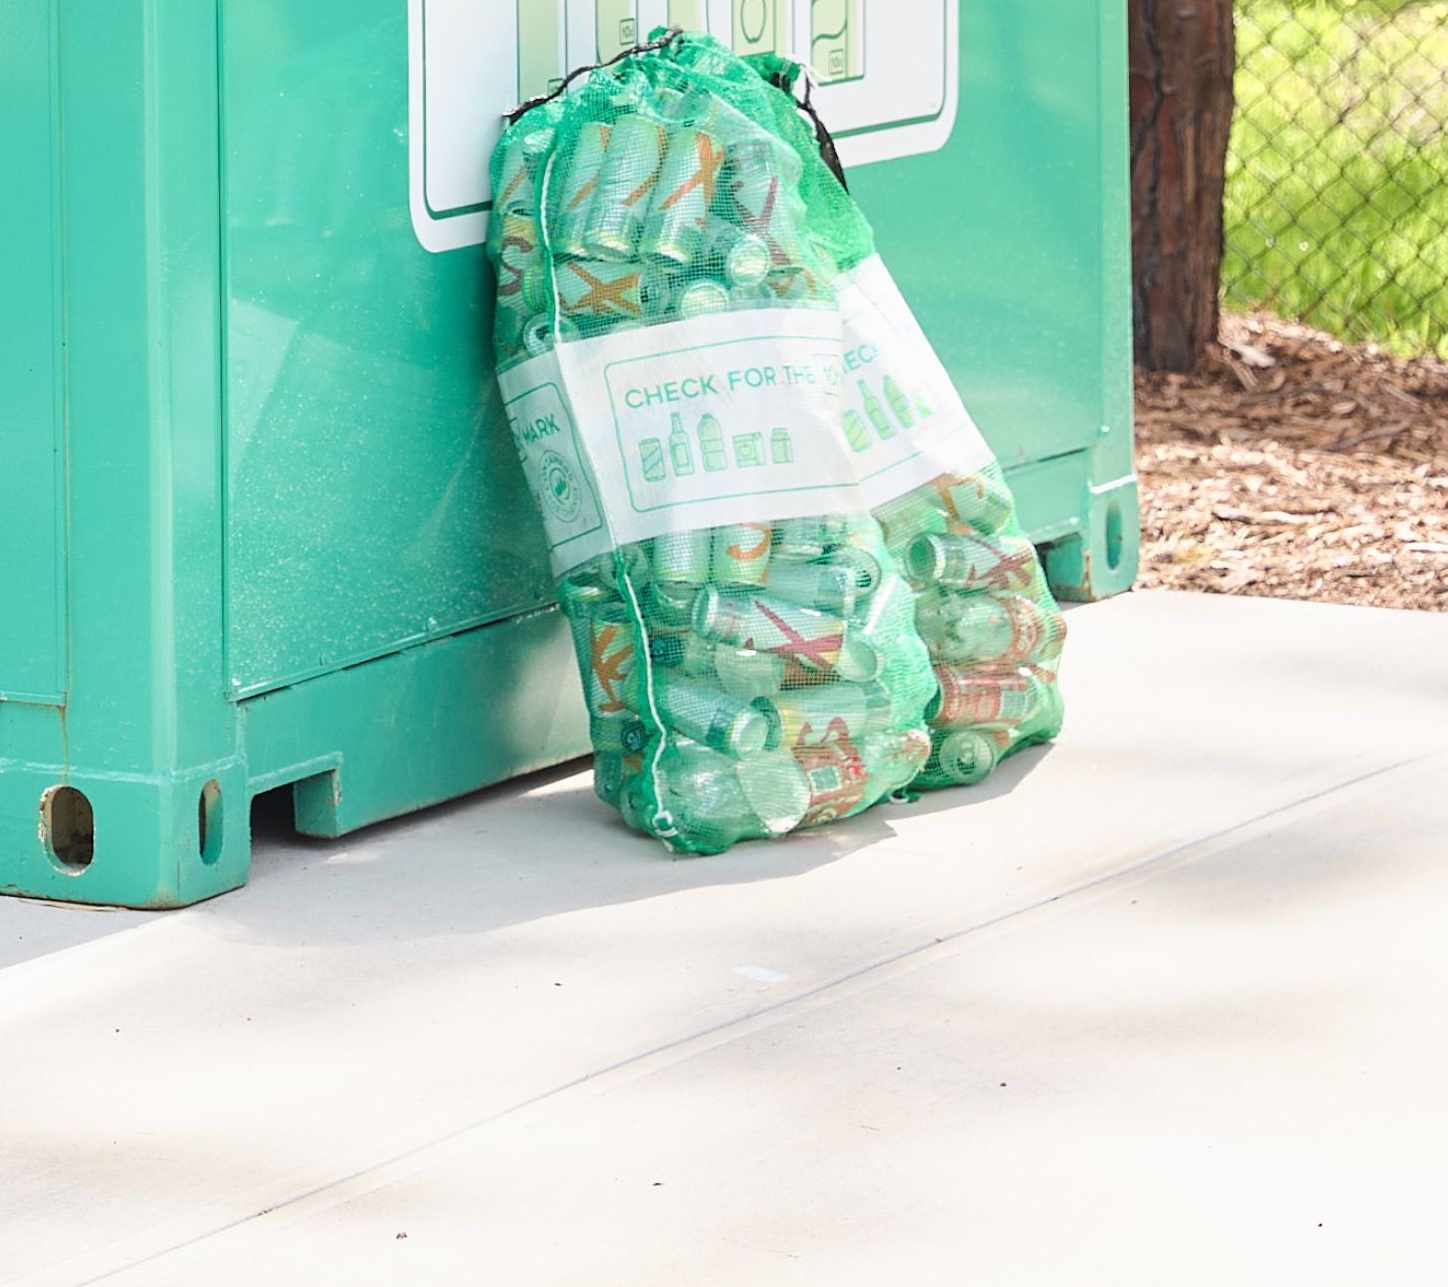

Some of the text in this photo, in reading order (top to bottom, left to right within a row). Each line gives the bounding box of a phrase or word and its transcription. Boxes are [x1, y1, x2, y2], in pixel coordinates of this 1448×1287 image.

[625, 375, 718, 408] CHECK
[727, 367, 775, 391] FOR
[522, 414, 560, 443] MARK
